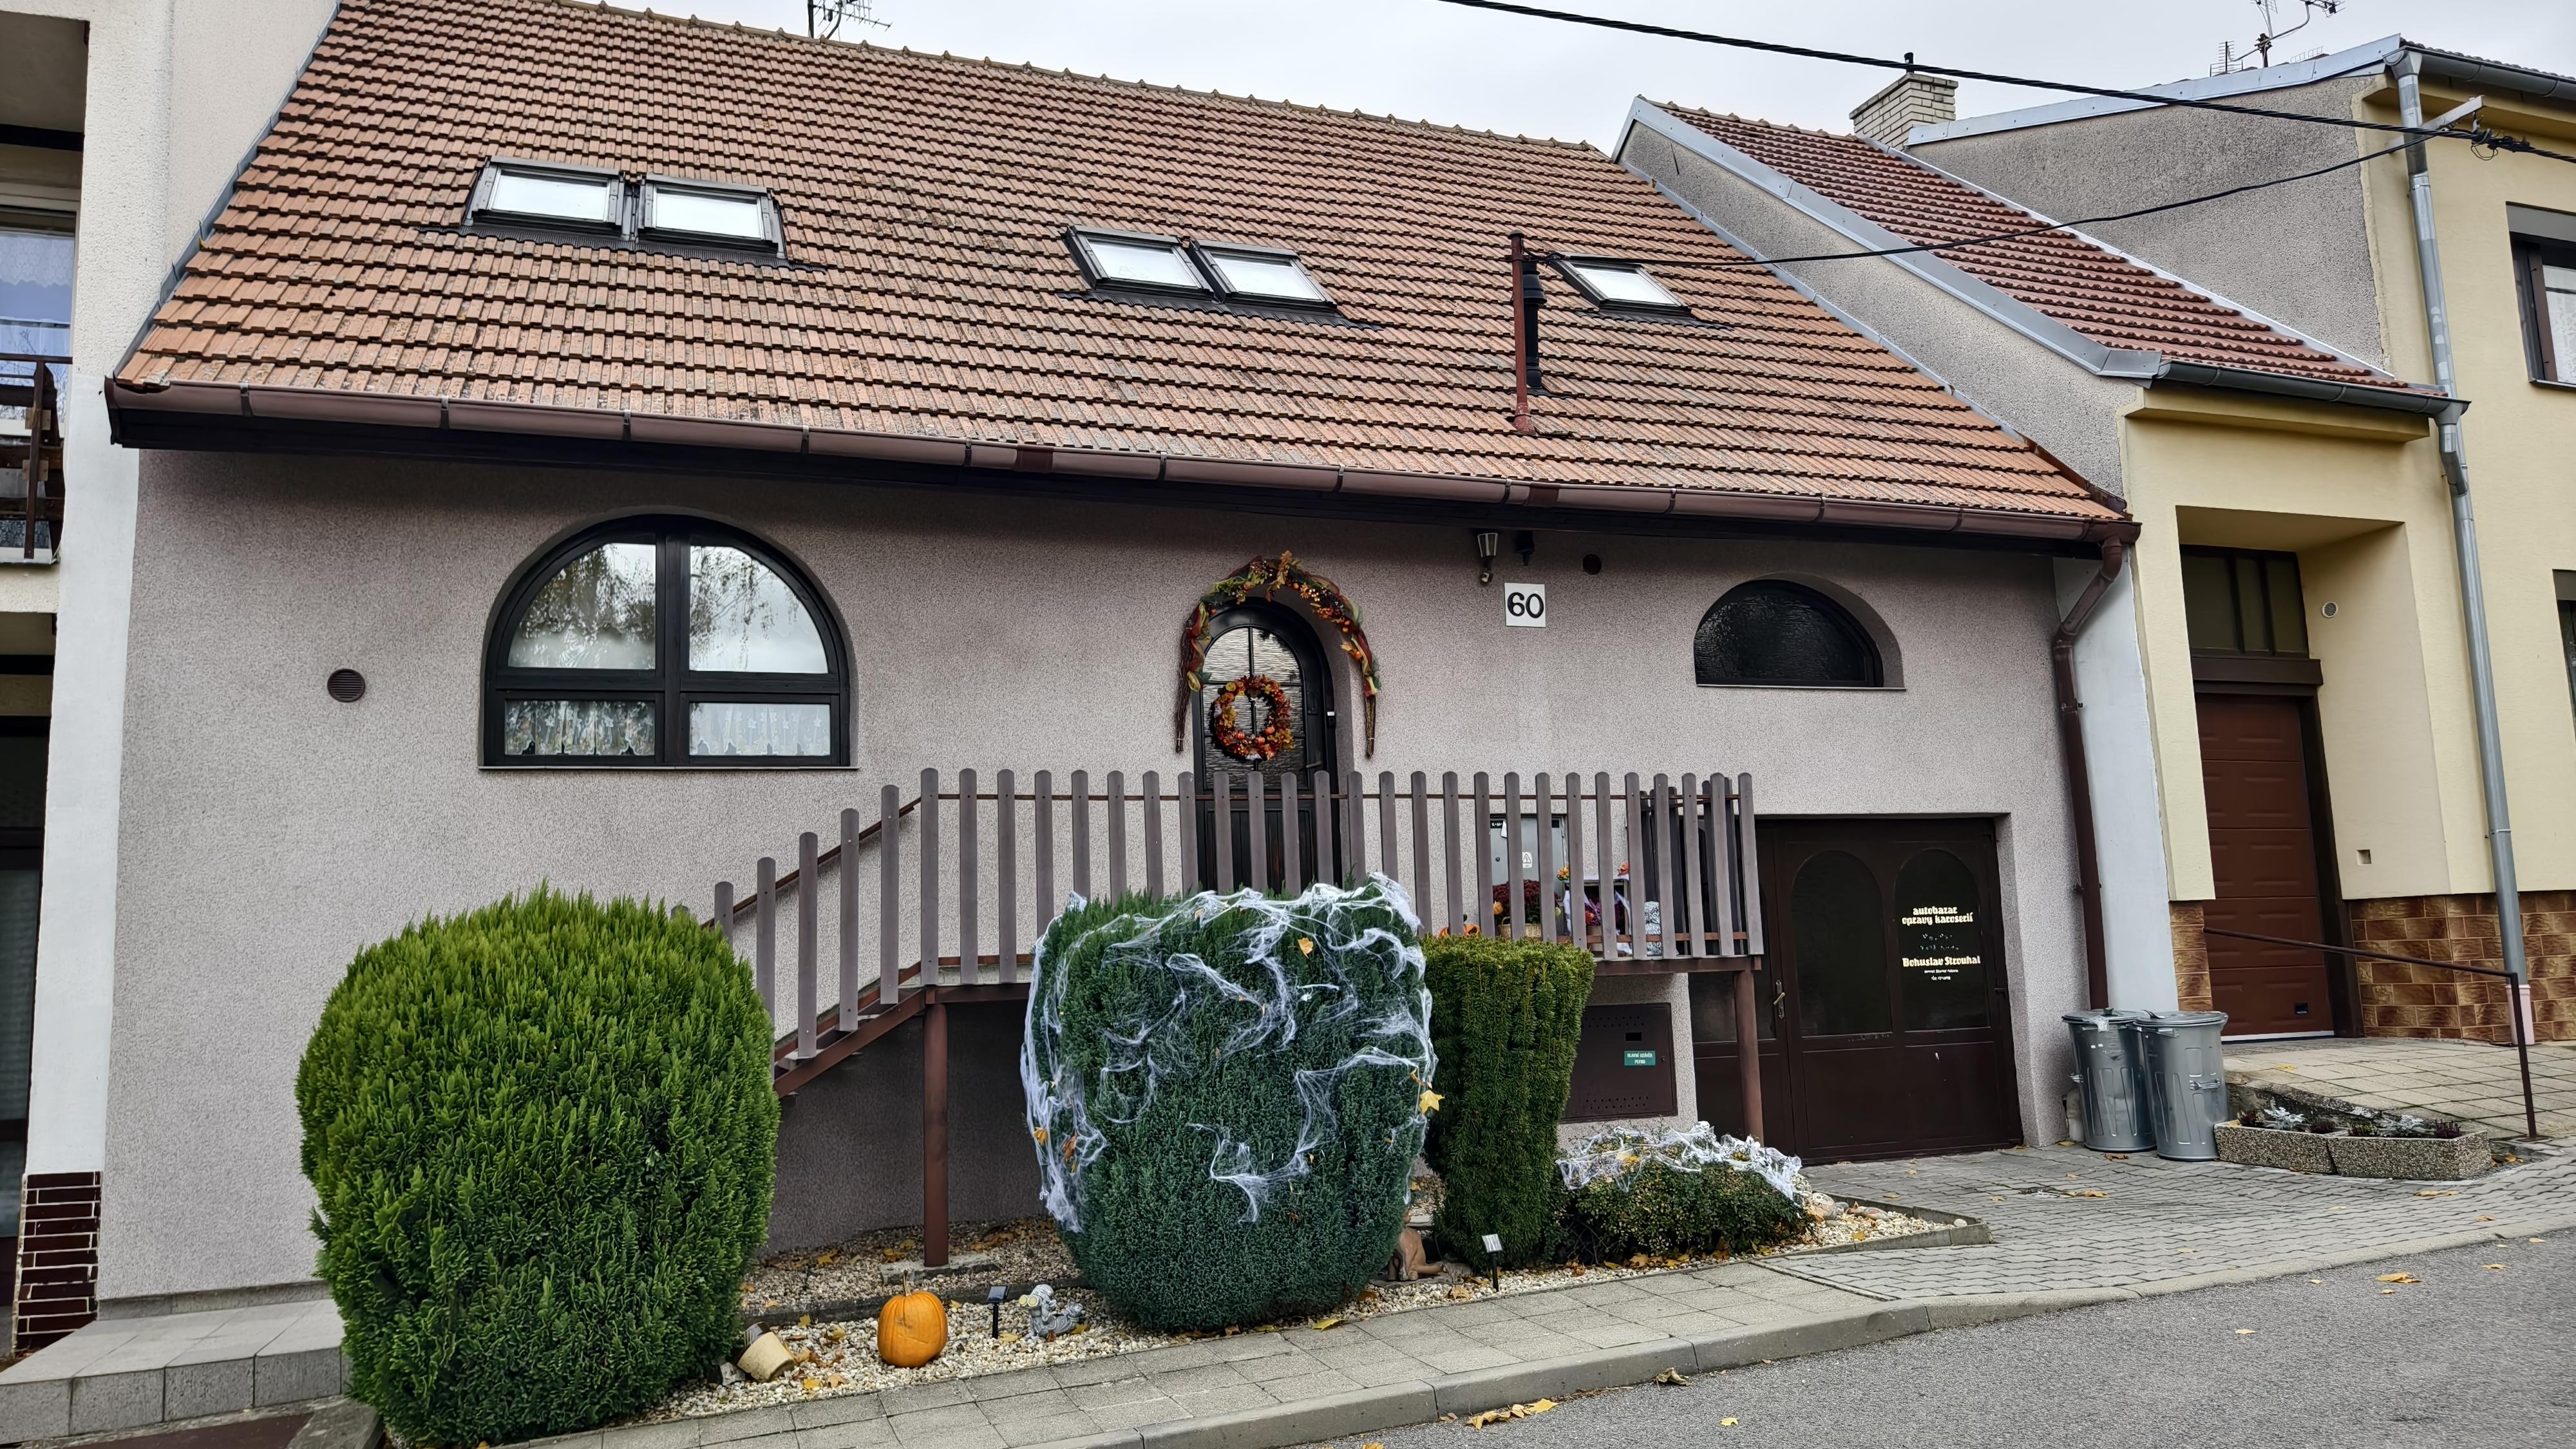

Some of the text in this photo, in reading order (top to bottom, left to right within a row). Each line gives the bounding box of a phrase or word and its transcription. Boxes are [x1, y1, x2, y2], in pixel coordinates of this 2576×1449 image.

[1507, 592, 1544, 619] 60
[1913, 906, 1958, 915] autobazar
[1902, 912, 1973, 926] opravy karoserií
[1902, 955, 1981, 967] Bohuslav Strouhal
